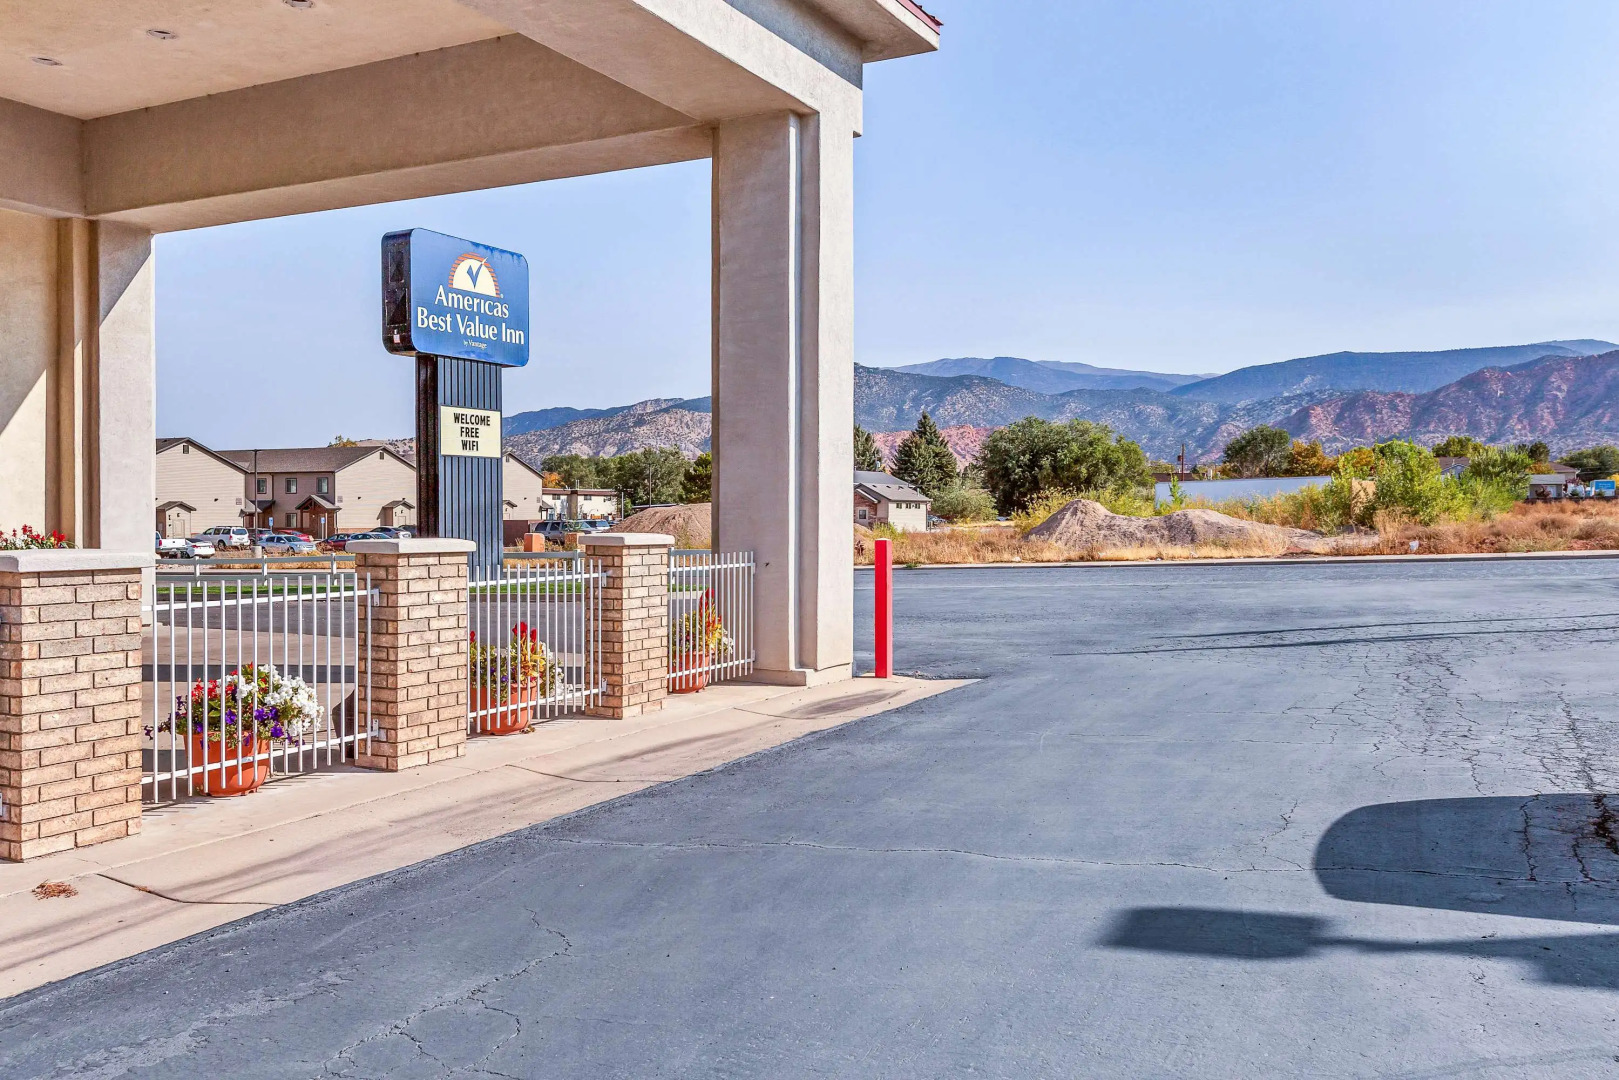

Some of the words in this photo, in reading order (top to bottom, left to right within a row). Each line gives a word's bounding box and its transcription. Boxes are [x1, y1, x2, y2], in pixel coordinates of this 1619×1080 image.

[434, 284, 509, 318] Americas
[417, 306, 452, 333] Best
[456, 313, 498, 341] Value
[502, 322, 524, 345] Inn
[453, 412, 491, 426] WELCOME
[460, 426, 480, 438] FREE
[461, 439, 479, 451] WIFI
